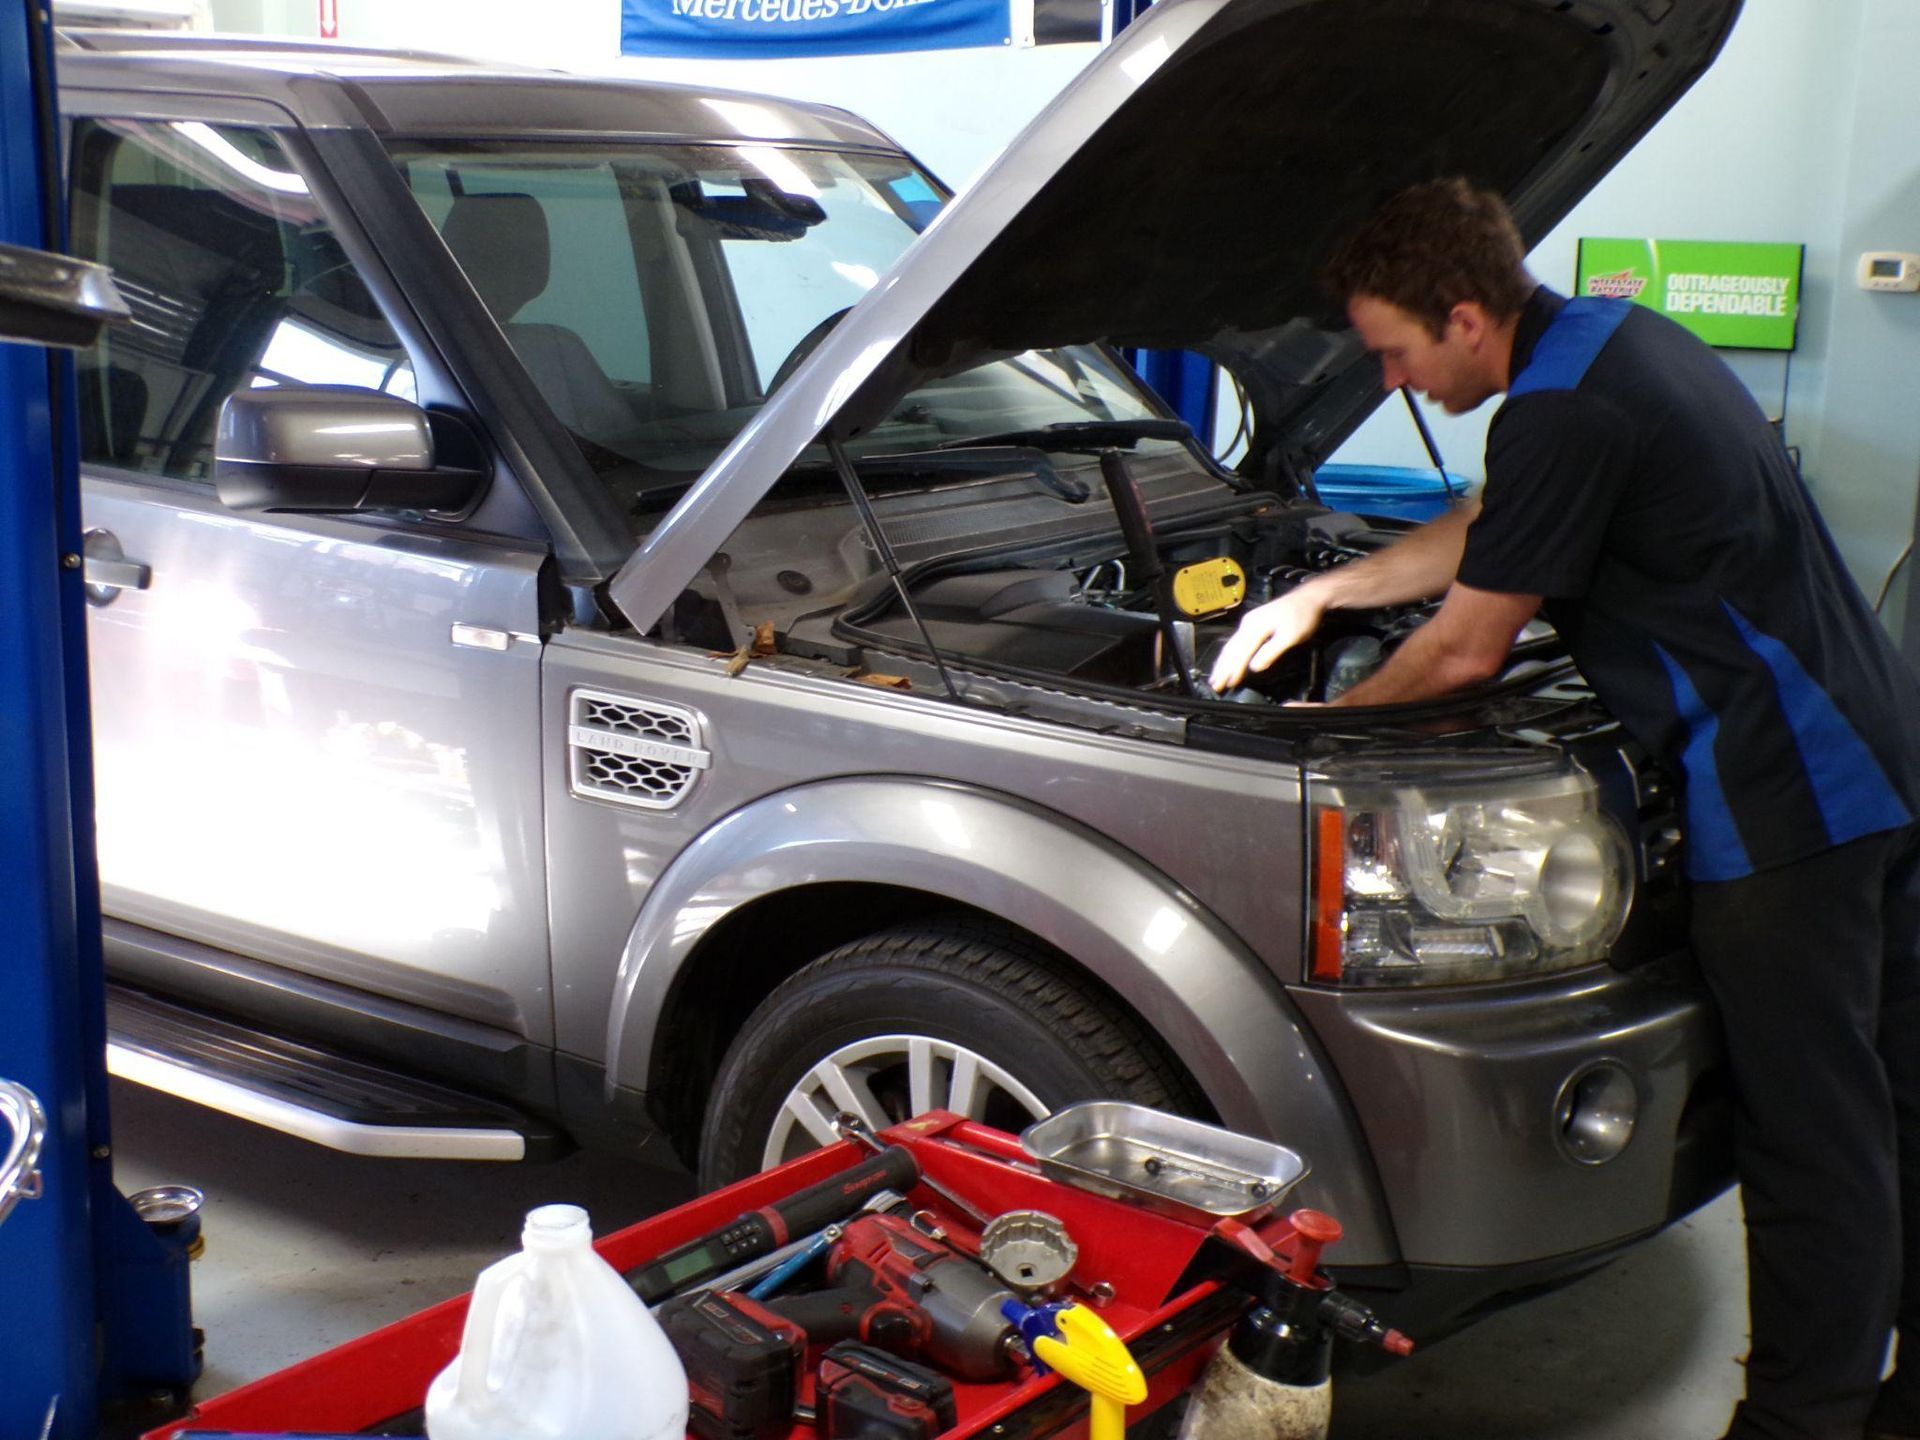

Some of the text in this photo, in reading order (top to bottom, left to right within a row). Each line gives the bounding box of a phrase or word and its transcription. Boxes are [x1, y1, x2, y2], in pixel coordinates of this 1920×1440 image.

[671, 0, 936, 21] Mercedes-
[1667, 274, 1789, 293] OUTRAGEOUSLY
[1666, 293, 1787, 315] DEPENDABLE
[576, 731, 697, 763] LAND ROVER
